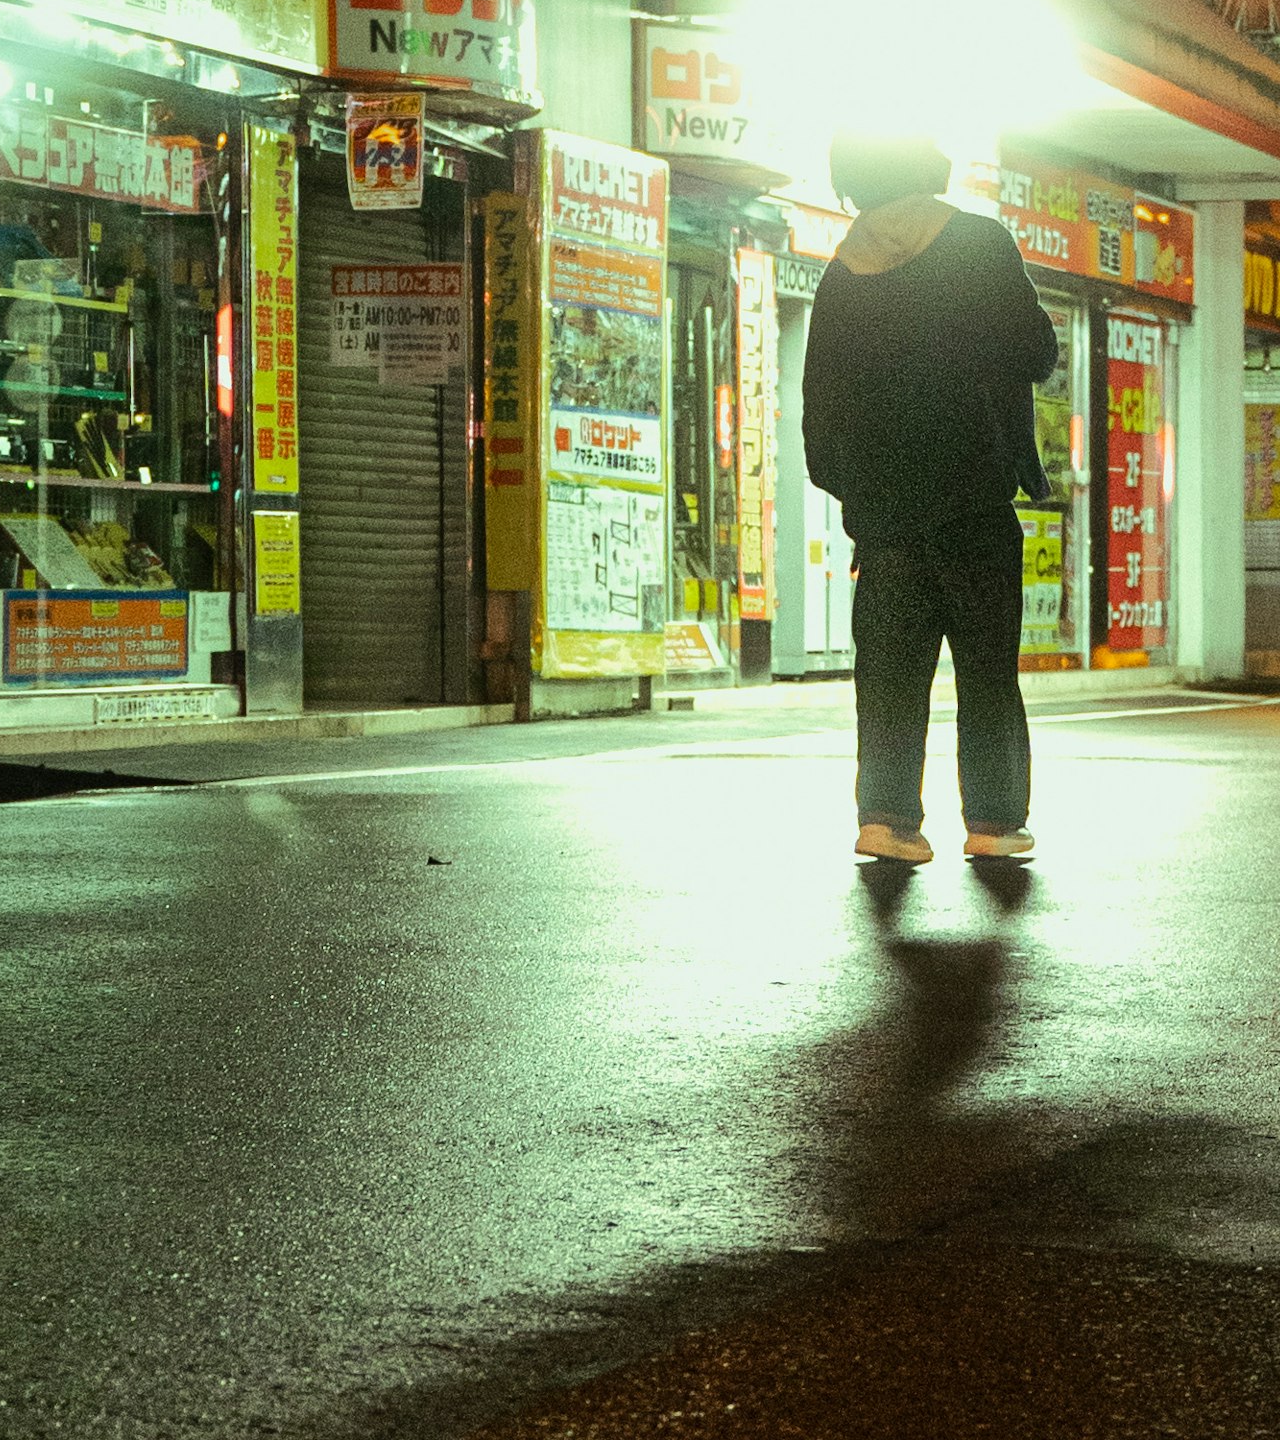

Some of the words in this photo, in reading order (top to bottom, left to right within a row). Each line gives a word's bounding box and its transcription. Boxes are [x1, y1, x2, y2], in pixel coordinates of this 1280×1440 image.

[562, 154, 652, 208] ROCKET
[274, 138, 297, 461] アマチュア無線機器展示
[333, 270, 461, 293] 営業時間のご案内
[254, 269, 275, 373] 秋葉原
[492, 207, 520, 422] アマチュア無線本館
[256, 403, 275, 461] 一番
[591, 420, 641, 452] ロケット
[573, 446, 657, 475] アマチュア無線本館はこちら
